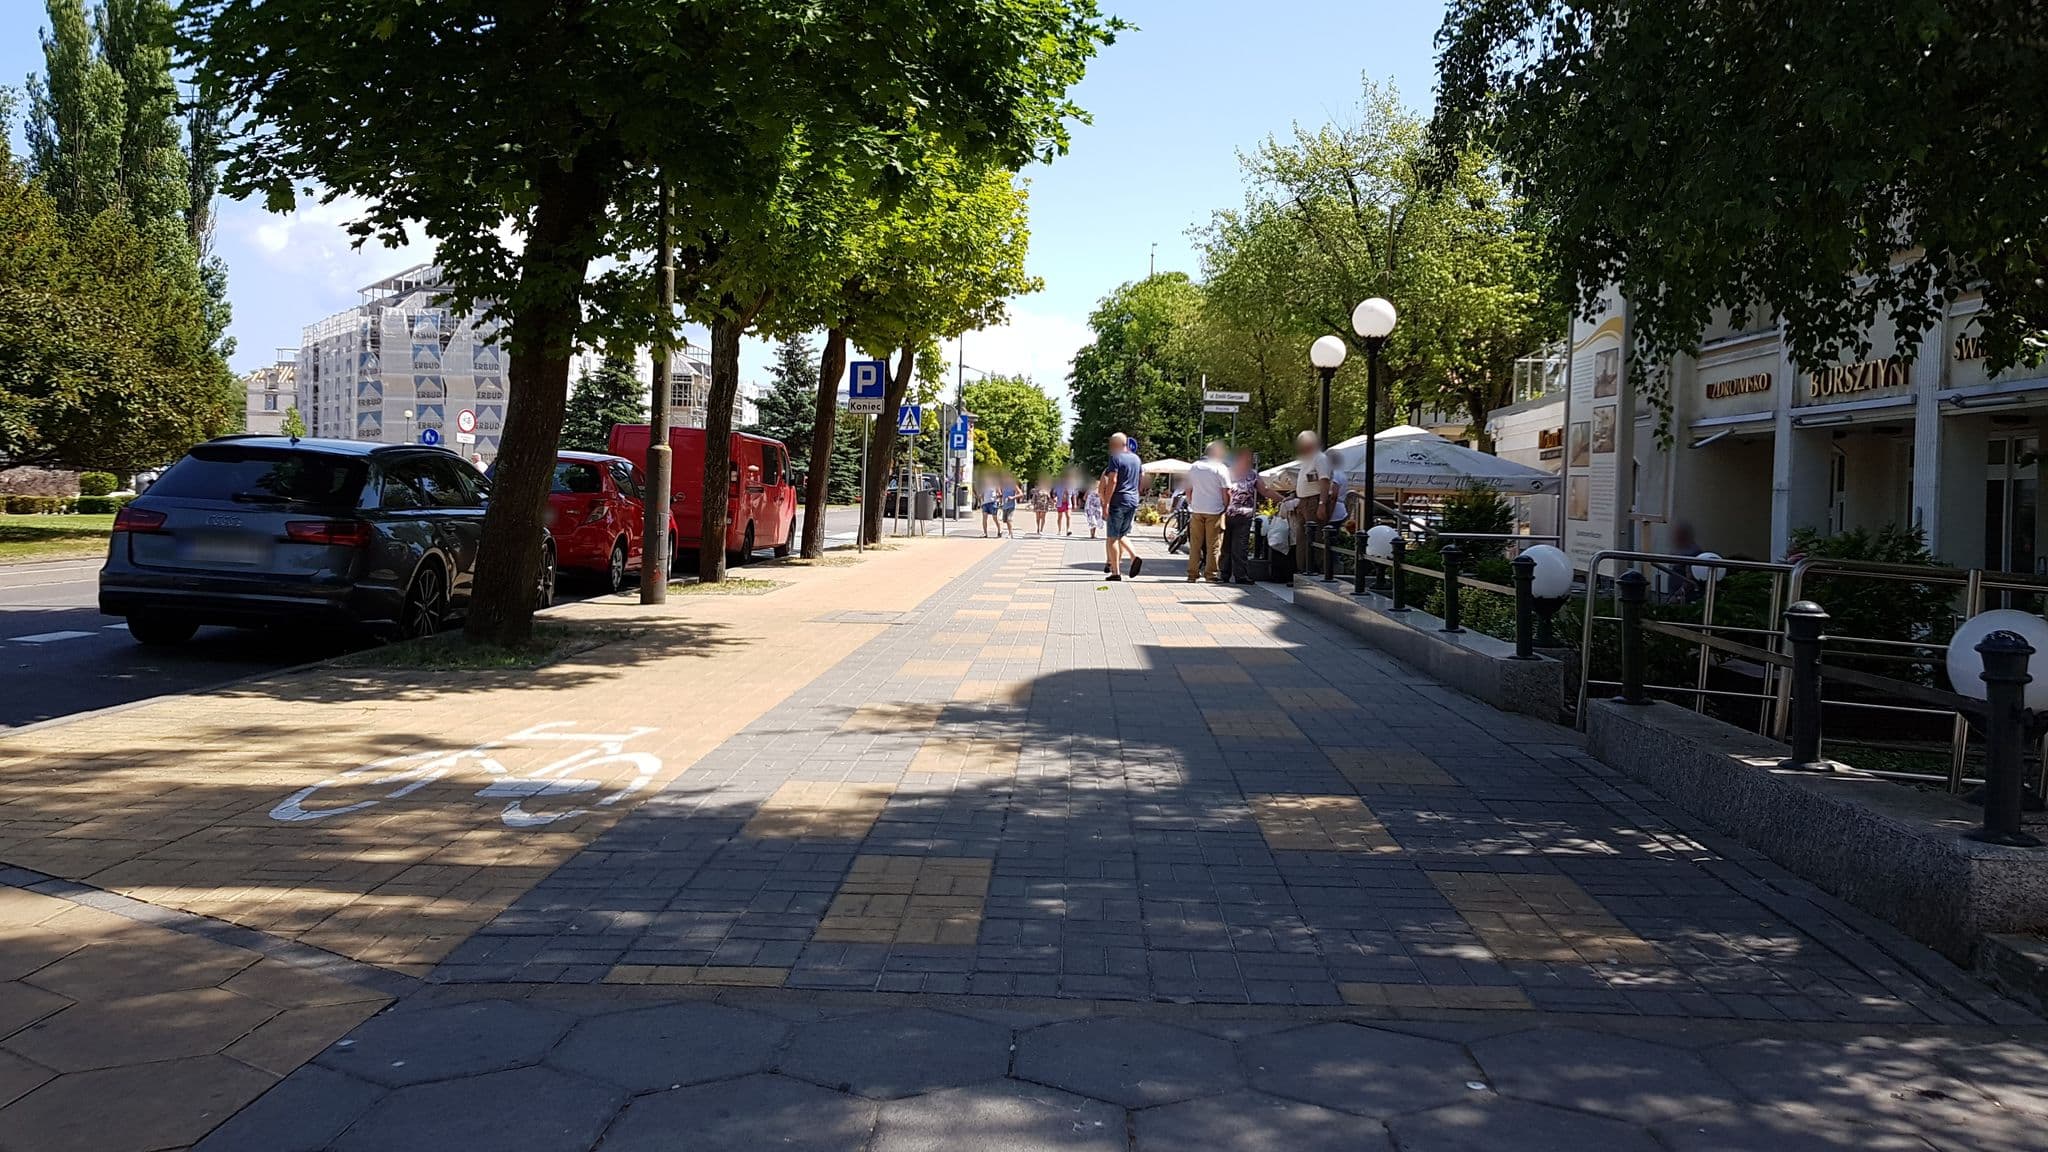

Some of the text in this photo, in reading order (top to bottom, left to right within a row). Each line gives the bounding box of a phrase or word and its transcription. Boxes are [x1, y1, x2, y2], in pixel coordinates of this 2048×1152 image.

[857, 365, 876, 394] P
[1810, 359, 1908, 397] BURSZTYN
[477, 391, 503, 399] ERBUD
[358, 399, 382, 407] ERBUD
[850, 402, 881, 411] Koniec
[358, 428, 382, 437] ERBUD
[954, 434, 964, 448] P
